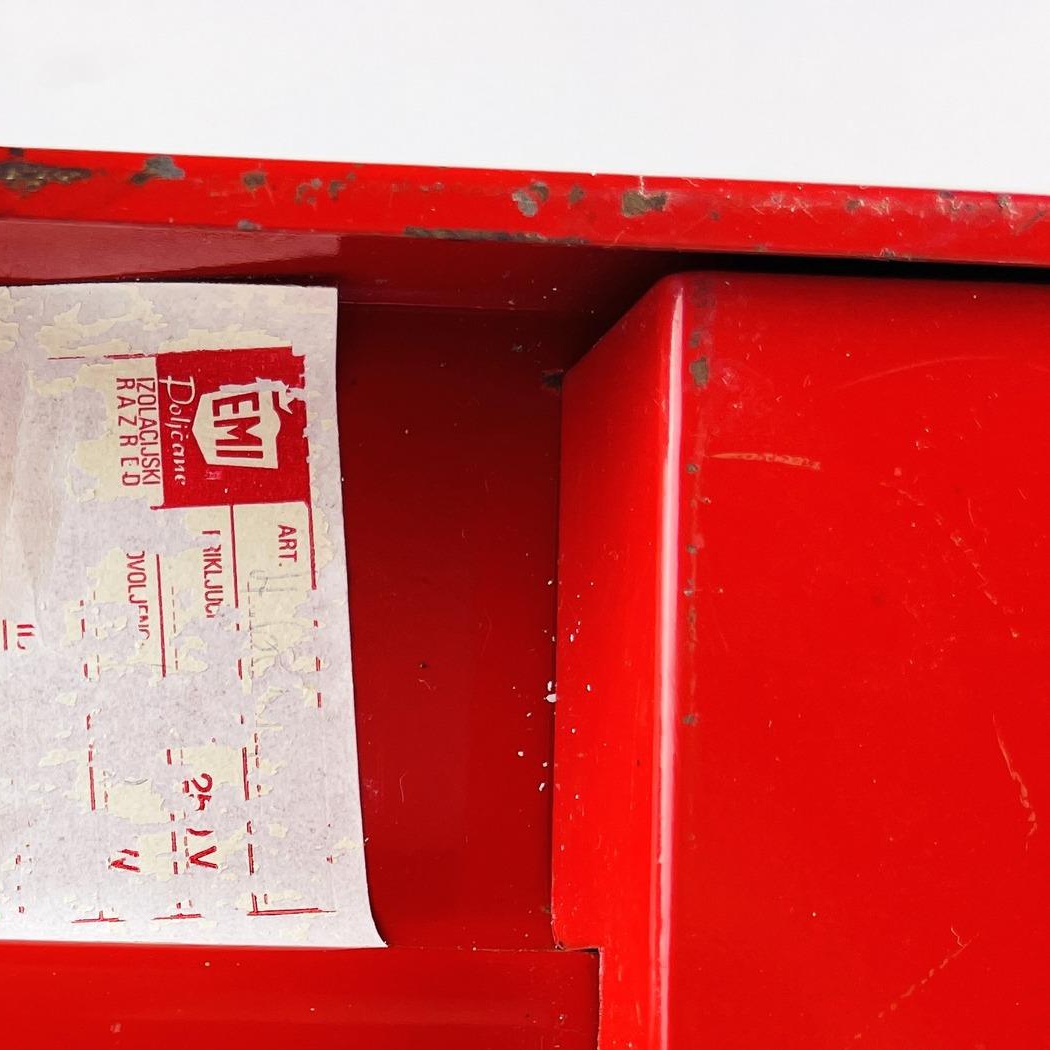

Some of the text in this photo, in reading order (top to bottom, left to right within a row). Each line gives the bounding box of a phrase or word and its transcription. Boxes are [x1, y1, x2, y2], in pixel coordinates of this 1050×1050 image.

[115, 377, 141, 487] RAZRED
[136, 377, 162, 485] IZOLACIJSKI
[158, 375, 196, 487] Poljčane
[211, 390, 264, 460] EMI
[277, 524, 298, 567] ART.
[188, 845, 218, 870] V
